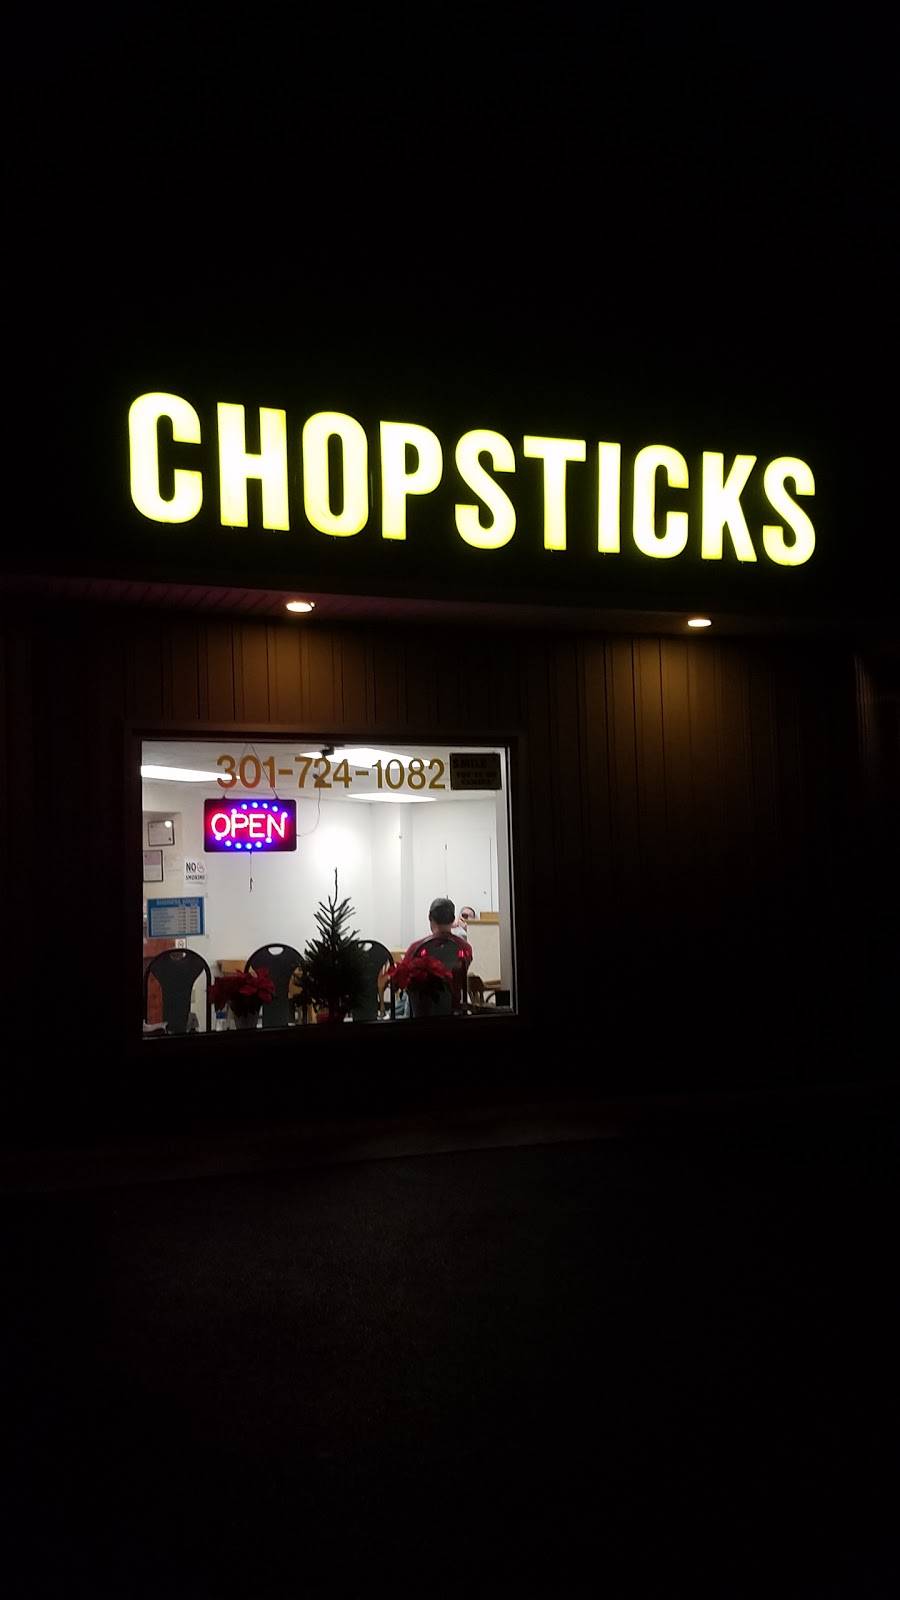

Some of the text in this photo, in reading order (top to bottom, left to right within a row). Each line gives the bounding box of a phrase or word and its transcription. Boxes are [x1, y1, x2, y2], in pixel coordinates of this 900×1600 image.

[128, 391, 816, 566] CHOPSTICKS
[217, 755, 445, 790] 301-724-1082
[211, 812, 287, 840] OPEN
[186, 862, 196, 872] NO
